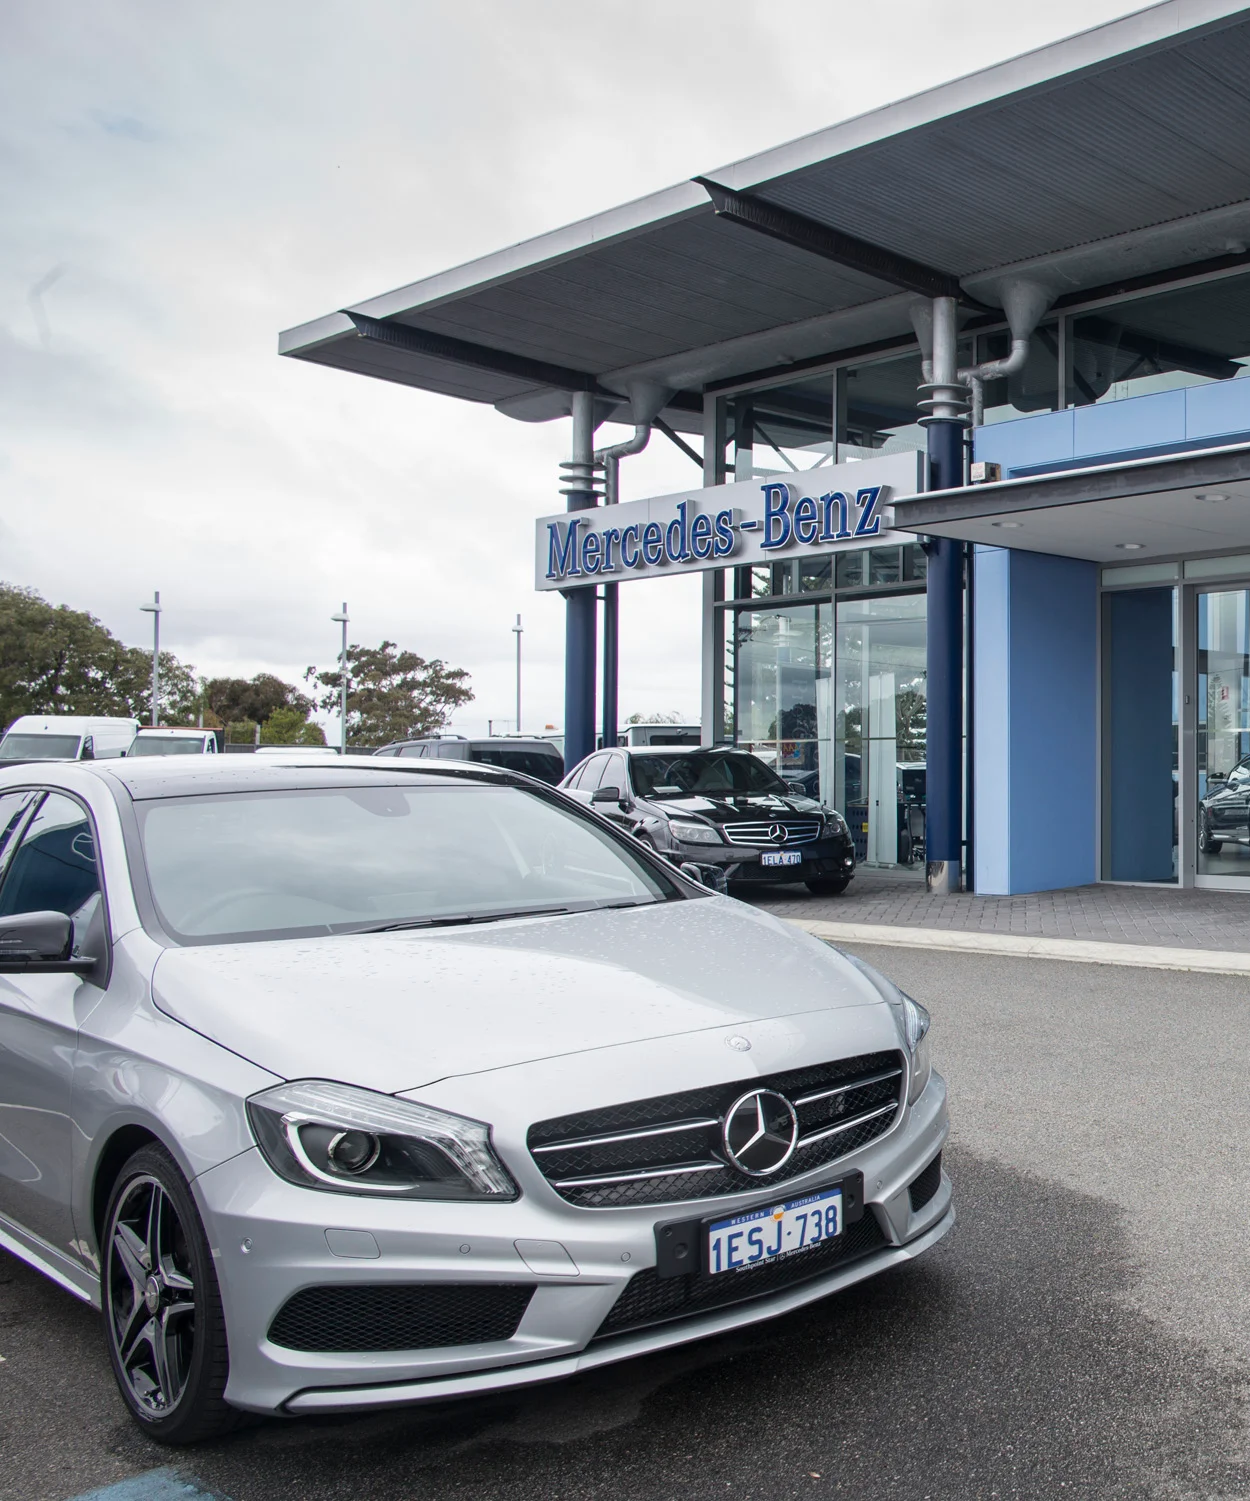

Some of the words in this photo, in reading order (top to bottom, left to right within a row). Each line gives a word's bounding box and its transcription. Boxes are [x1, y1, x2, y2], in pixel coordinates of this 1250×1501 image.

[545, 482, 888, 580] Mercedes-Benz
[731, 1211, 765, 1225] WESTERN
[790, 1195, 821, 1209] AUSTRALIA
[736, 1260, 765, 1273] Southpoint
[765, 1256, 776, 1264] Star
